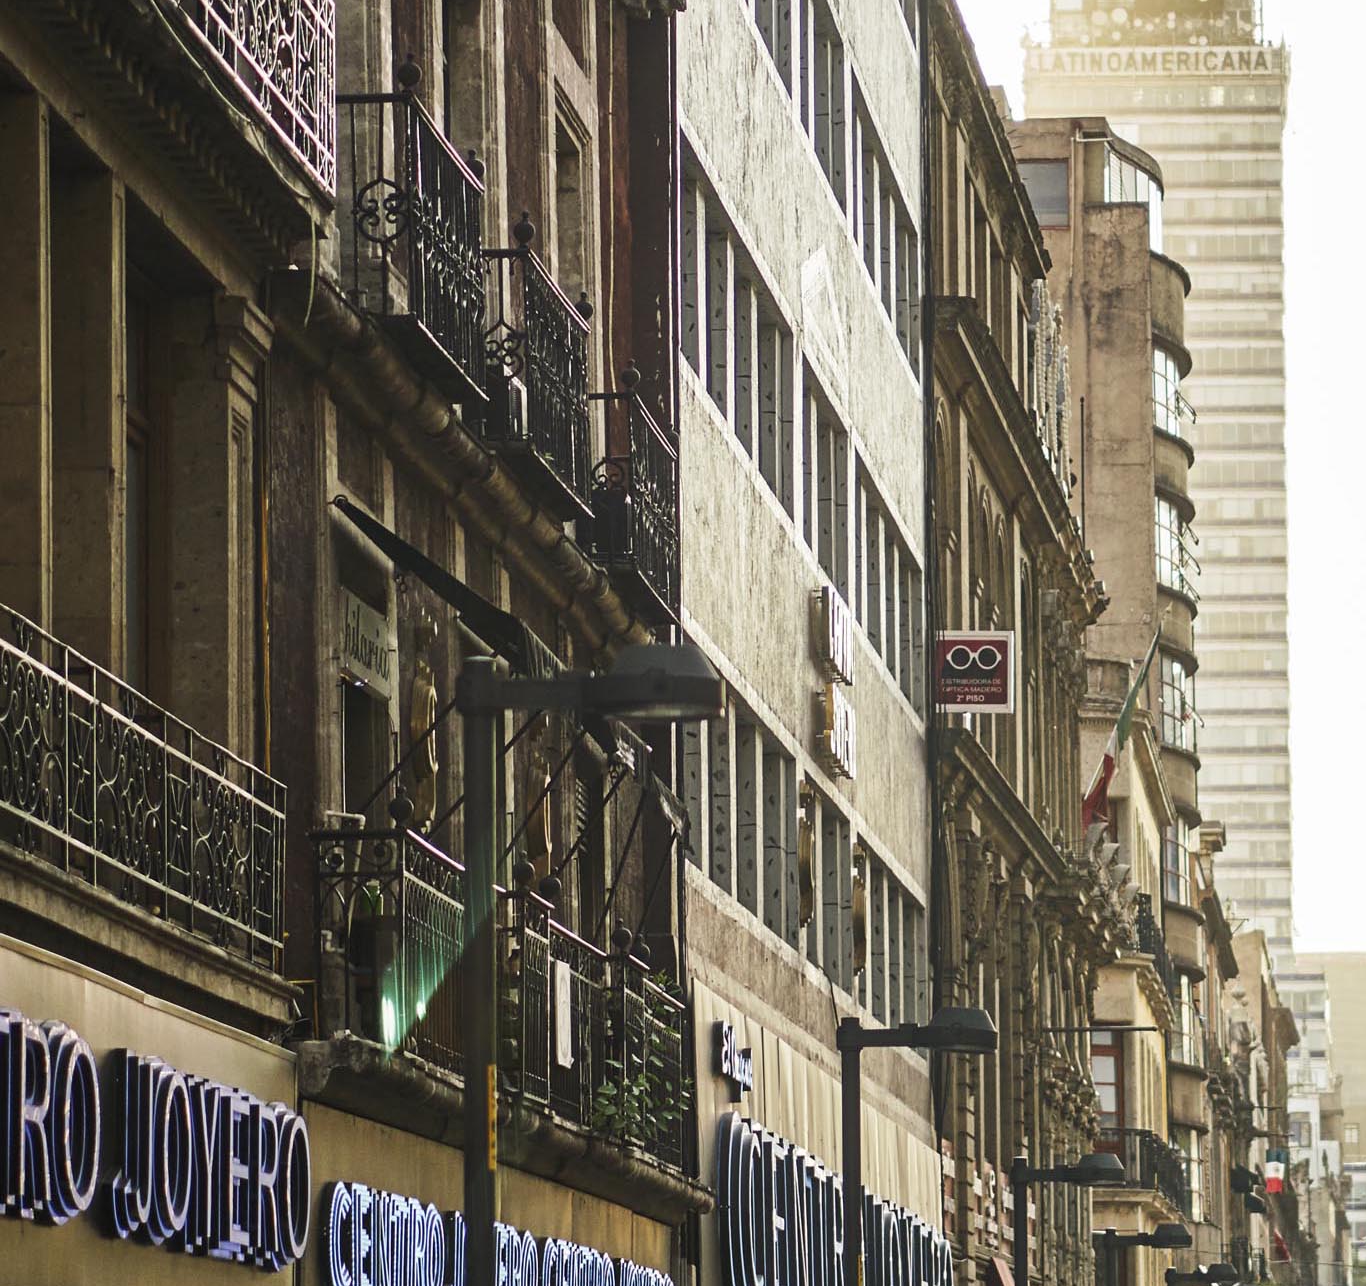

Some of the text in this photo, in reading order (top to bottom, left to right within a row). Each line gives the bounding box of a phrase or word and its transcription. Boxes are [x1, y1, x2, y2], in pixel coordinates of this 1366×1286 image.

[1039, 50, 1268, 73] LATINOAMERICANA
[0, 1011, 311, 1271] RO JOYERO
